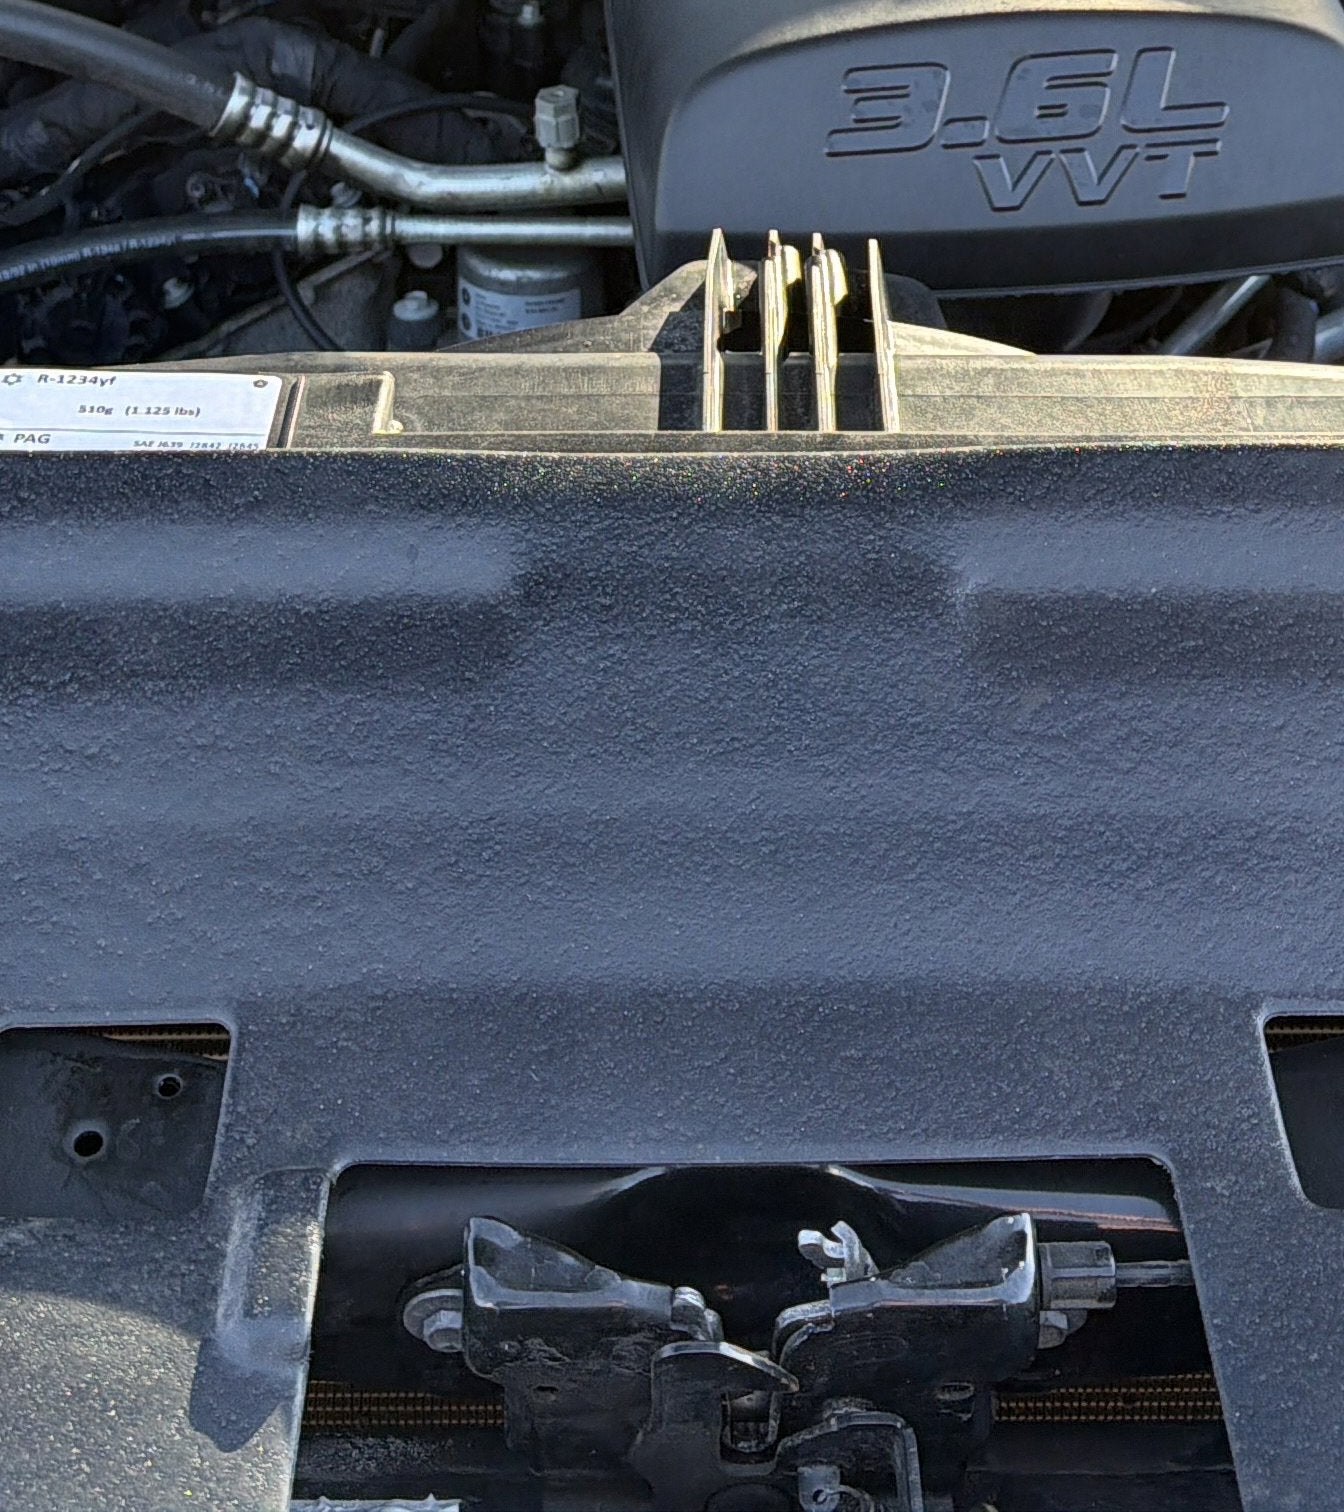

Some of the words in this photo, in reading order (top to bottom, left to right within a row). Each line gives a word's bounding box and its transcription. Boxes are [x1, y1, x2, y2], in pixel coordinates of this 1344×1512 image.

[825, 46, 1230, 157] 3.6L
[973, 138, 1222, 213] VVT
[37, 374, 117, 387] R-1234yf
[78, 405, 113, 416] 510g
[174, 406, 201, 418] lbs)
[13, 433, 51, 445] PAG
[133, 440, 155, 448] SAE
